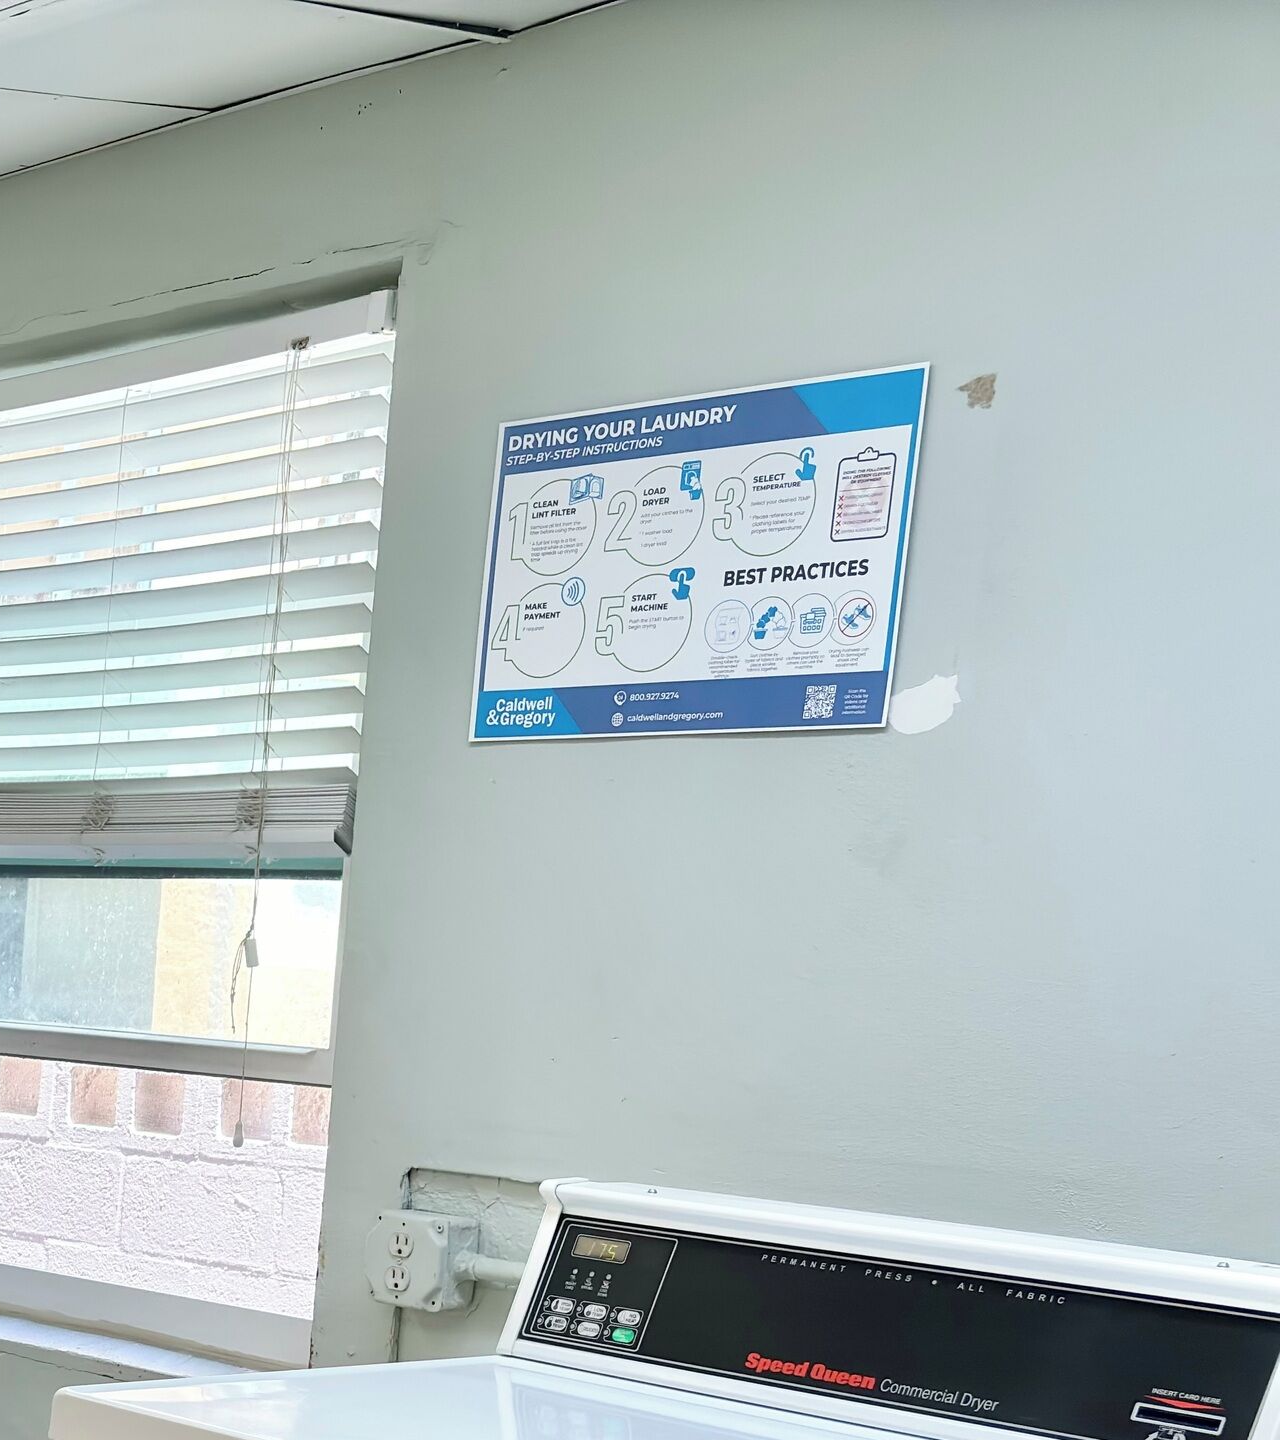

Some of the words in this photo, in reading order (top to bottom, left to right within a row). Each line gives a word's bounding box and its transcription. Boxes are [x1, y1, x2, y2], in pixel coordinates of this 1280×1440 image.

[509, 429, 578, 452] DRYING
[583, 420, 635, 441] YOUR
[641, 404, 737, 434] LAUNDRY
[506, 448, 580, 467] STEP-BY-STEP
[582, 437, 663, 457] INSTRUCTIONS
[753, 473, 786, 483] SELECT
[753, 481, 801, 491] TEMPERATURE
[643, 487, 666, 496] LOAD
[533, 500, 558, 508] CLEAN
[643, 497, 669, 506] DRYER
[532, 511, 549, 519] LINT
[551, 508, 576, 517] FILTER
[724, 568, 767, 586] BEST
[771, 559, 869, 583] PRACTICES
[525, 602, 547, 610] MAKE
[631, 603, 668, 612] MACHINE
[524, 612, 560, 620] PAYMENT
[630, 692, 679, 701] 800.927.9274
[496, 696, 553, 711] Caldwell
[627, 710, 723, 722] caldwellandgregory.com
[761, 1254, 847, 1272] PERMANENT
[865, 1269, 913, 1282] PRESS
[957, 1282, 984, 1293] ALL
[1006, 1289, 1066, 1305] FABRIC
[745, 1352, 810, 1378] Speed
[810, 1364, 876, 1390] Queen
[880, 1379, 957, 1404] Commercial
[960, 1393, 999, 1413] Dryer
[1152, 1388, 1178, 1397] INSERT
[1179, 1392, 1200, 1400] CARD
